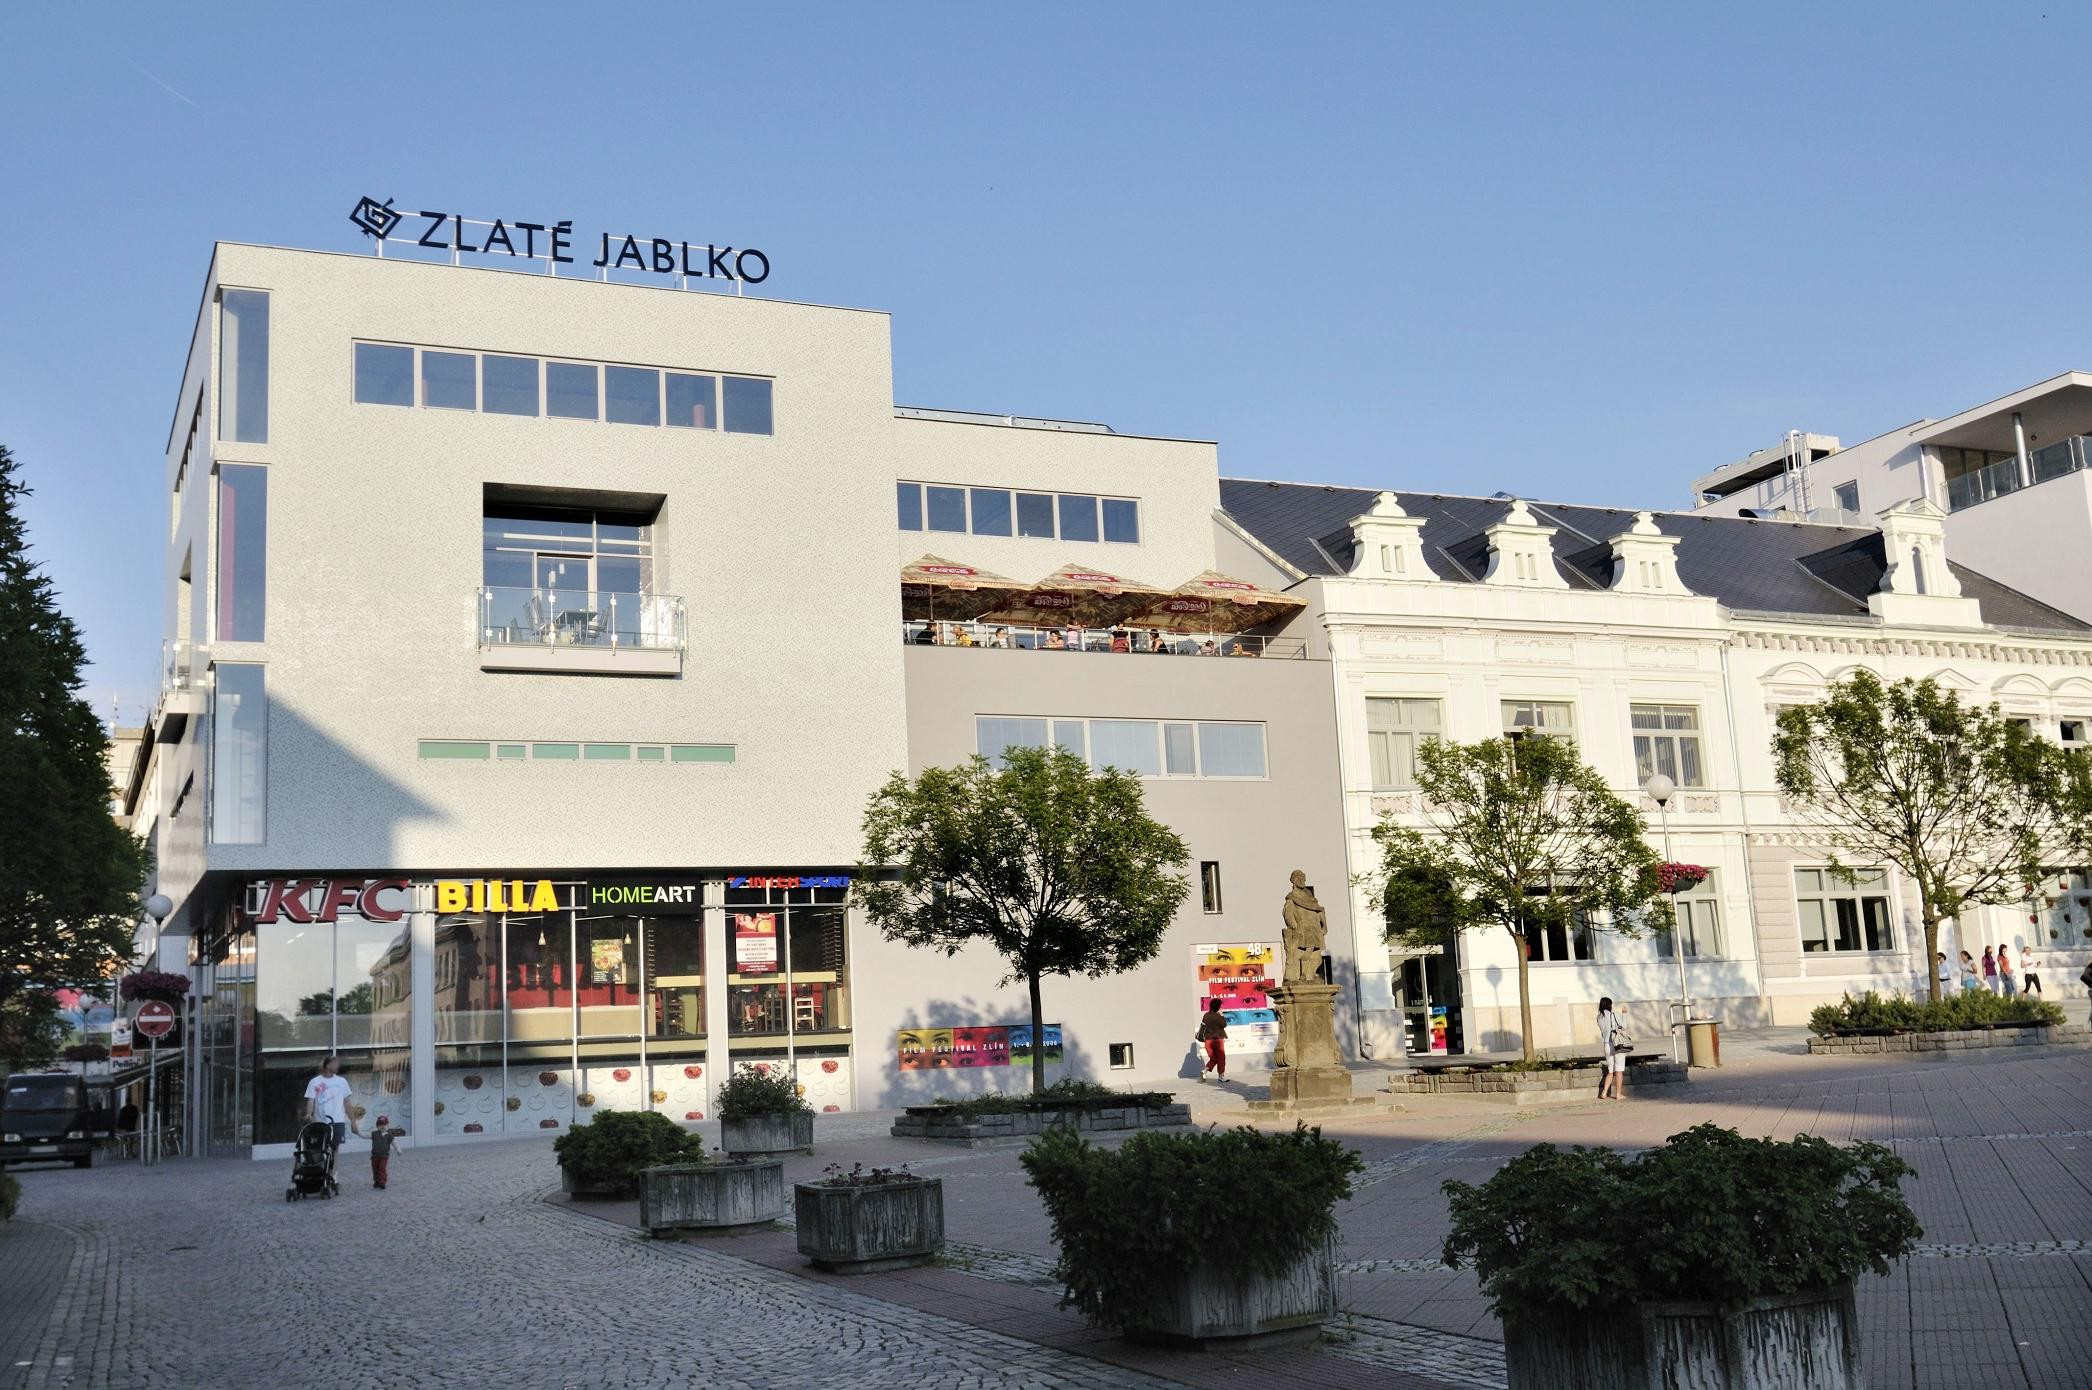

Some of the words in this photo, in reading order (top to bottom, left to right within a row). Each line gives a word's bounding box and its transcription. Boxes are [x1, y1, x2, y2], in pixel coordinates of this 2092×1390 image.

[418, 210, 574, 263] ZLATÉ
[593, 232, 770, 284] JABLKO
[254, 879, 409, 923] KFC
[438, 880, 559, 913] BILLA
[1252, 975, 1265, 983] ZLÍN
[903, 1046, 926, 1054] FILM
[932, 1044, 977, 1054] FESTIVAL
[982, 1042, 1004, 1051] ZLÍN
